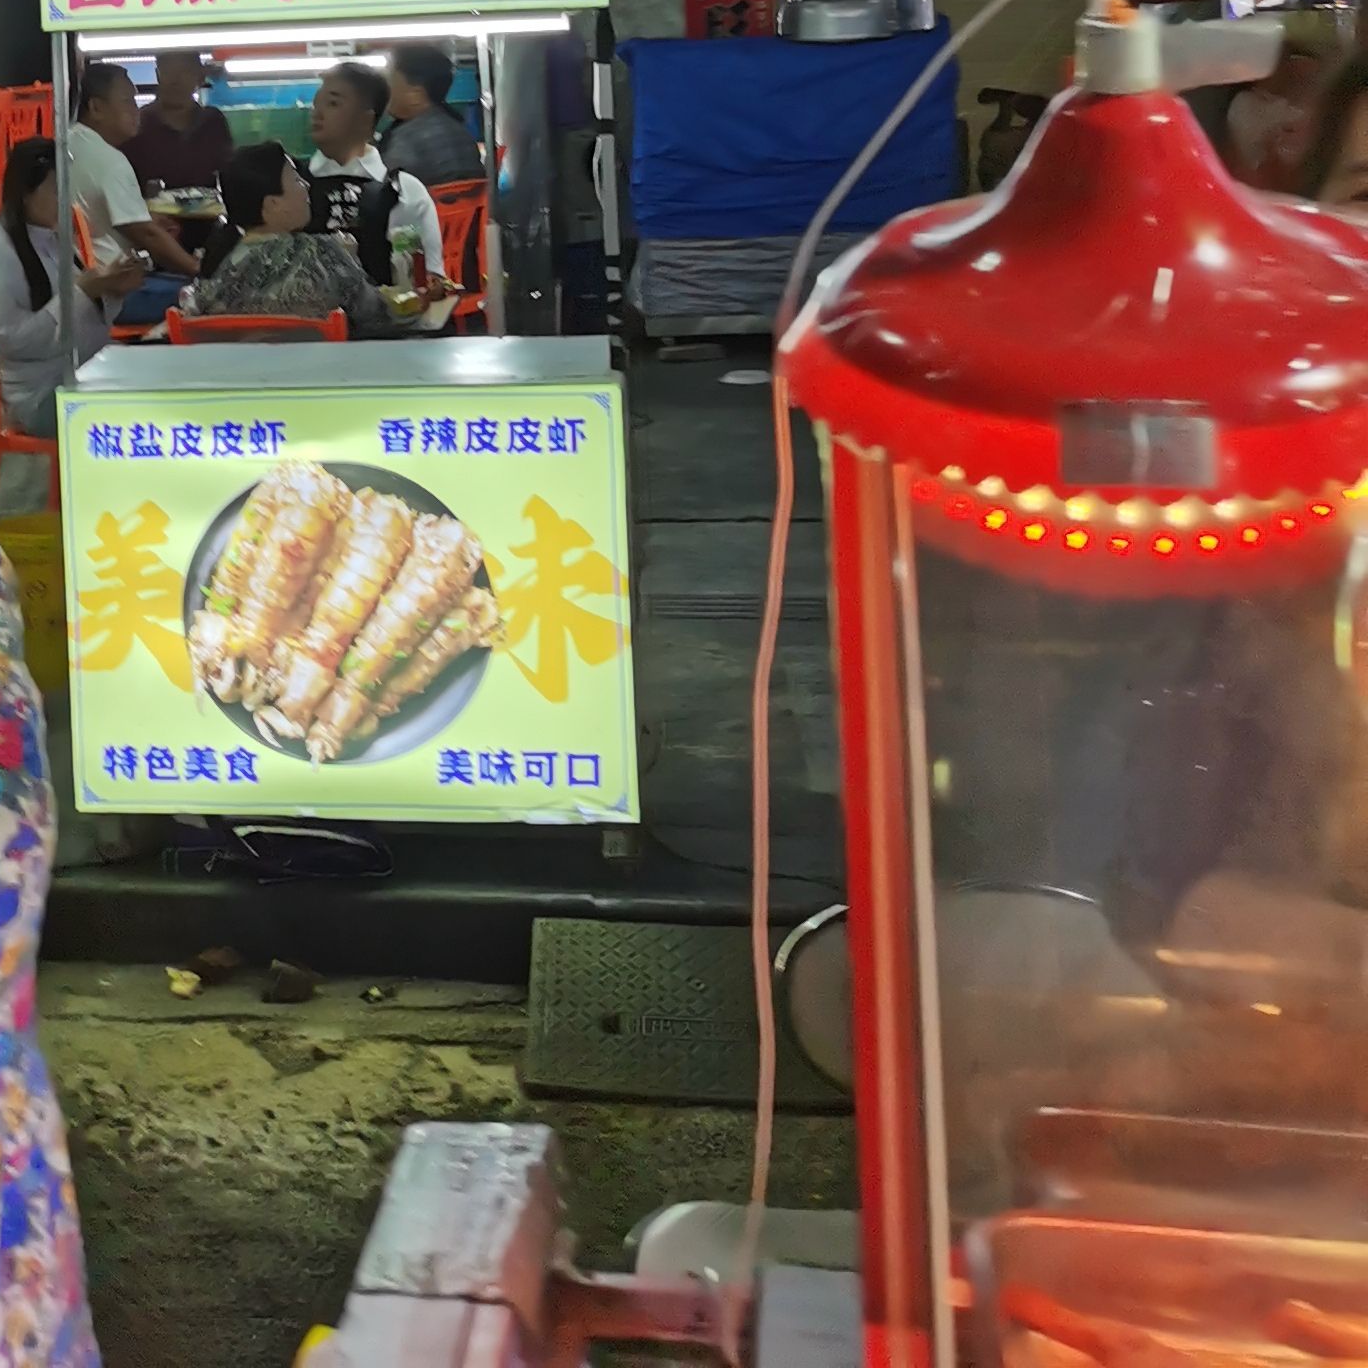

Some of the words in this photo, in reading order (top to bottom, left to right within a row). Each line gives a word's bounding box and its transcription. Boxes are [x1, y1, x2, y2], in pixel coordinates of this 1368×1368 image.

[88, 419, 287, 459] 椒盐皮皮虾
[378, 416, 588, 455] 香辣皮皮虾
[103, 745, 260, 783] 特色美食
[438, 748, 601, 788] 美味可口
